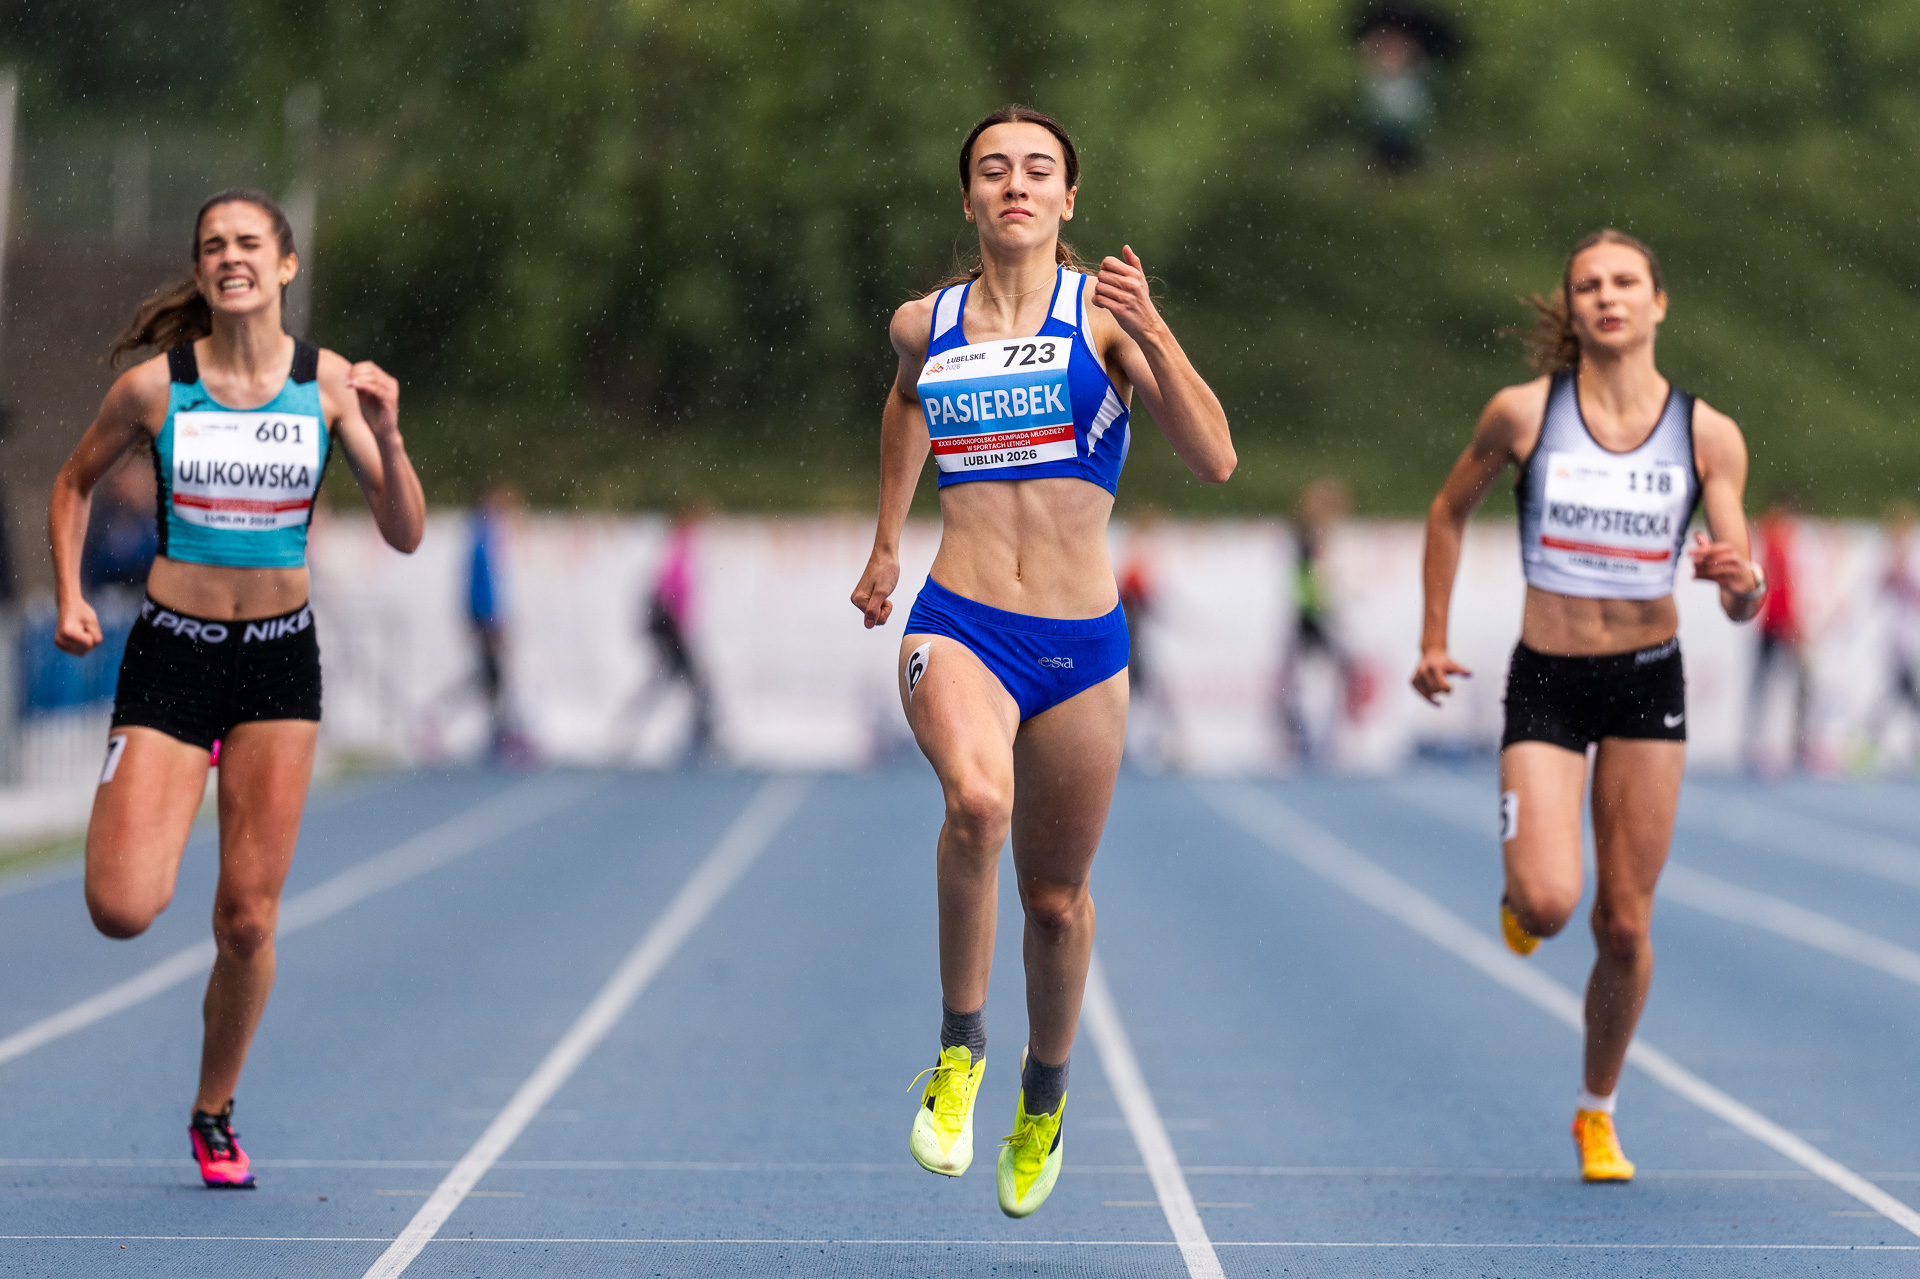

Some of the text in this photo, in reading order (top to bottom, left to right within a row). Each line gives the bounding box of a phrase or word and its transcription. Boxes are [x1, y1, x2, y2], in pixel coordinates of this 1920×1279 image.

[947, 353, 986, 364] LUBELSKIE
[1003, 342, 1056, 368] 723
[924, 383, 1065, 426] PASIERBEK
[256, 420, 303, 444] 601
[952, 436, 997, 446] OGÓLNOPOLSKA
[997, 432, 1030, 442] OLIMPIADA
[1030, 427, 1065, 438] MŁODZIEŻY
[973, 442, 1006, 451] SPORTACH
[1006, 439, 1031, 448] LETNICH
[963, 449, 1038, 467] LUBLIN 2026
[178, 460, 311, 489] ULIKOWSKA
[1628, 471, 1672, 495] 118
[1549, 501, 1670, 537] KOPYSTECKA
[151, 610, 229, 643] PRO
[242, 604, 312, 643] NIKE
[909, 652, 924, 692] 6
